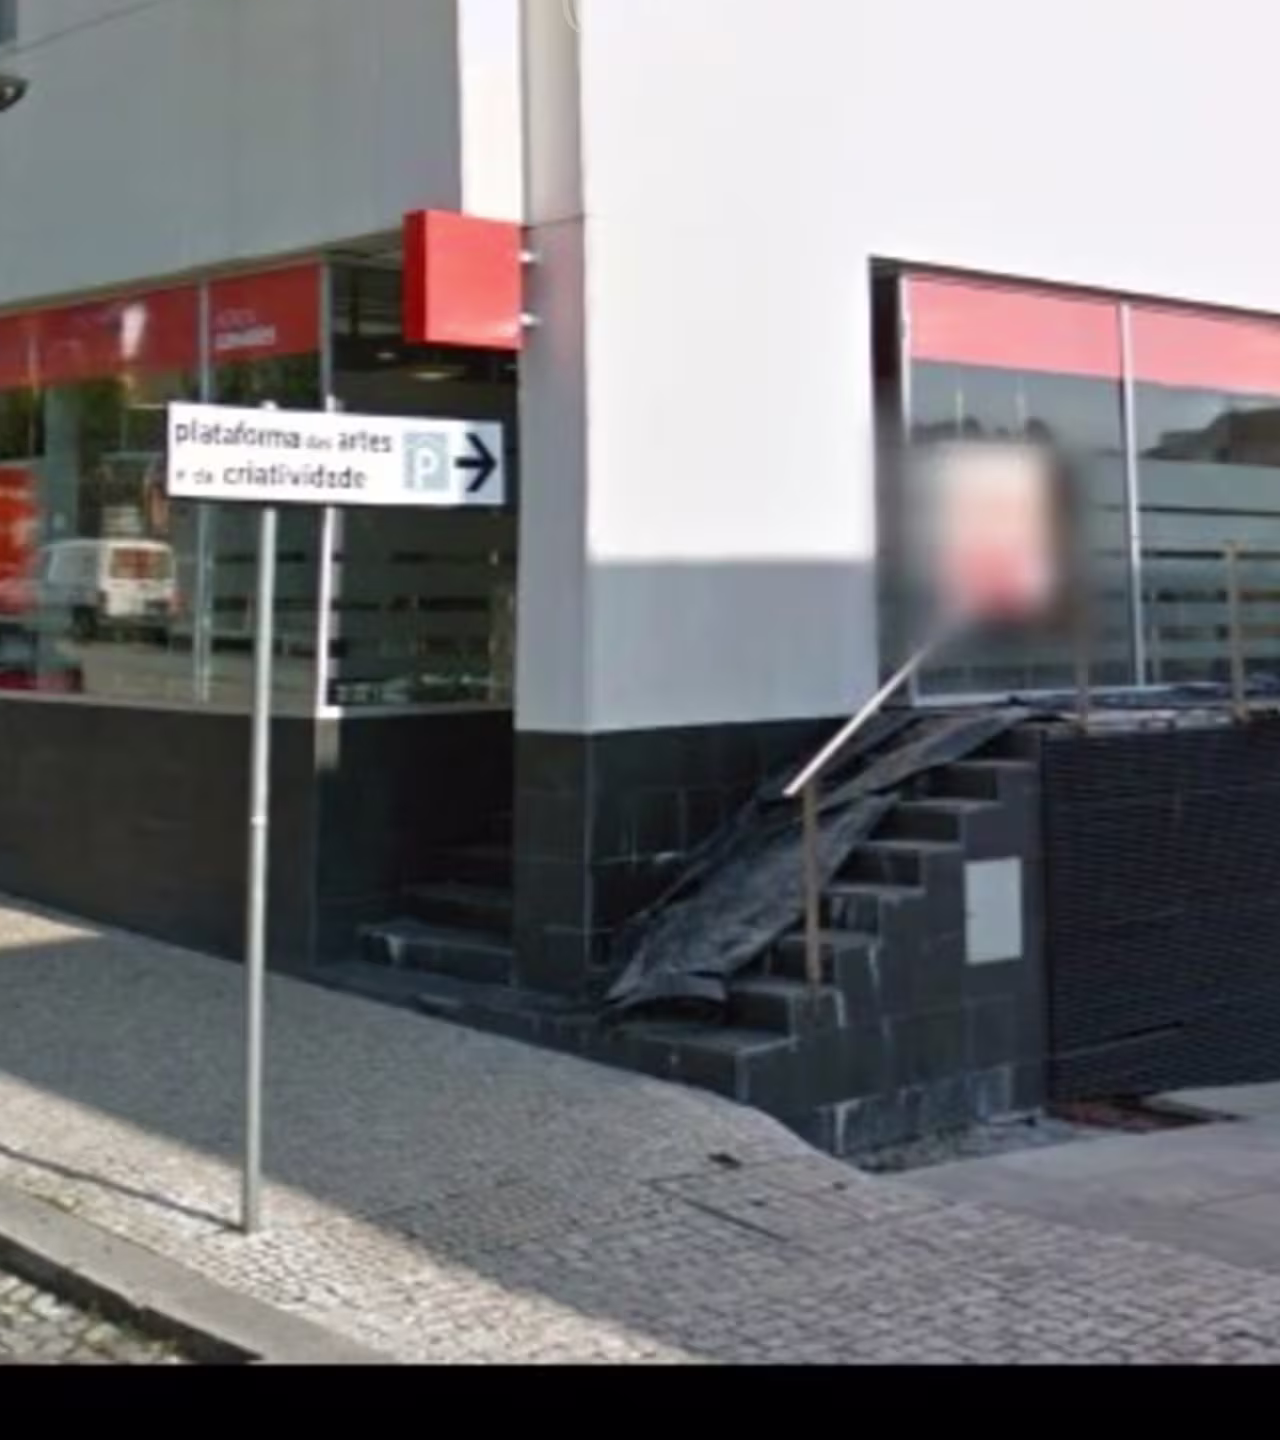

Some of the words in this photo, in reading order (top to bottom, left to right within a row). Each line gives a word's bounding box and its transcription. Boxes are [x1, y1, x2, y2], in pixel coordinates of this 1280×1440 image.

[176, 417, 300, 449] plataforma
[337, 429, 393, 454] artes
[222, 459, 367, 490] criatividade
